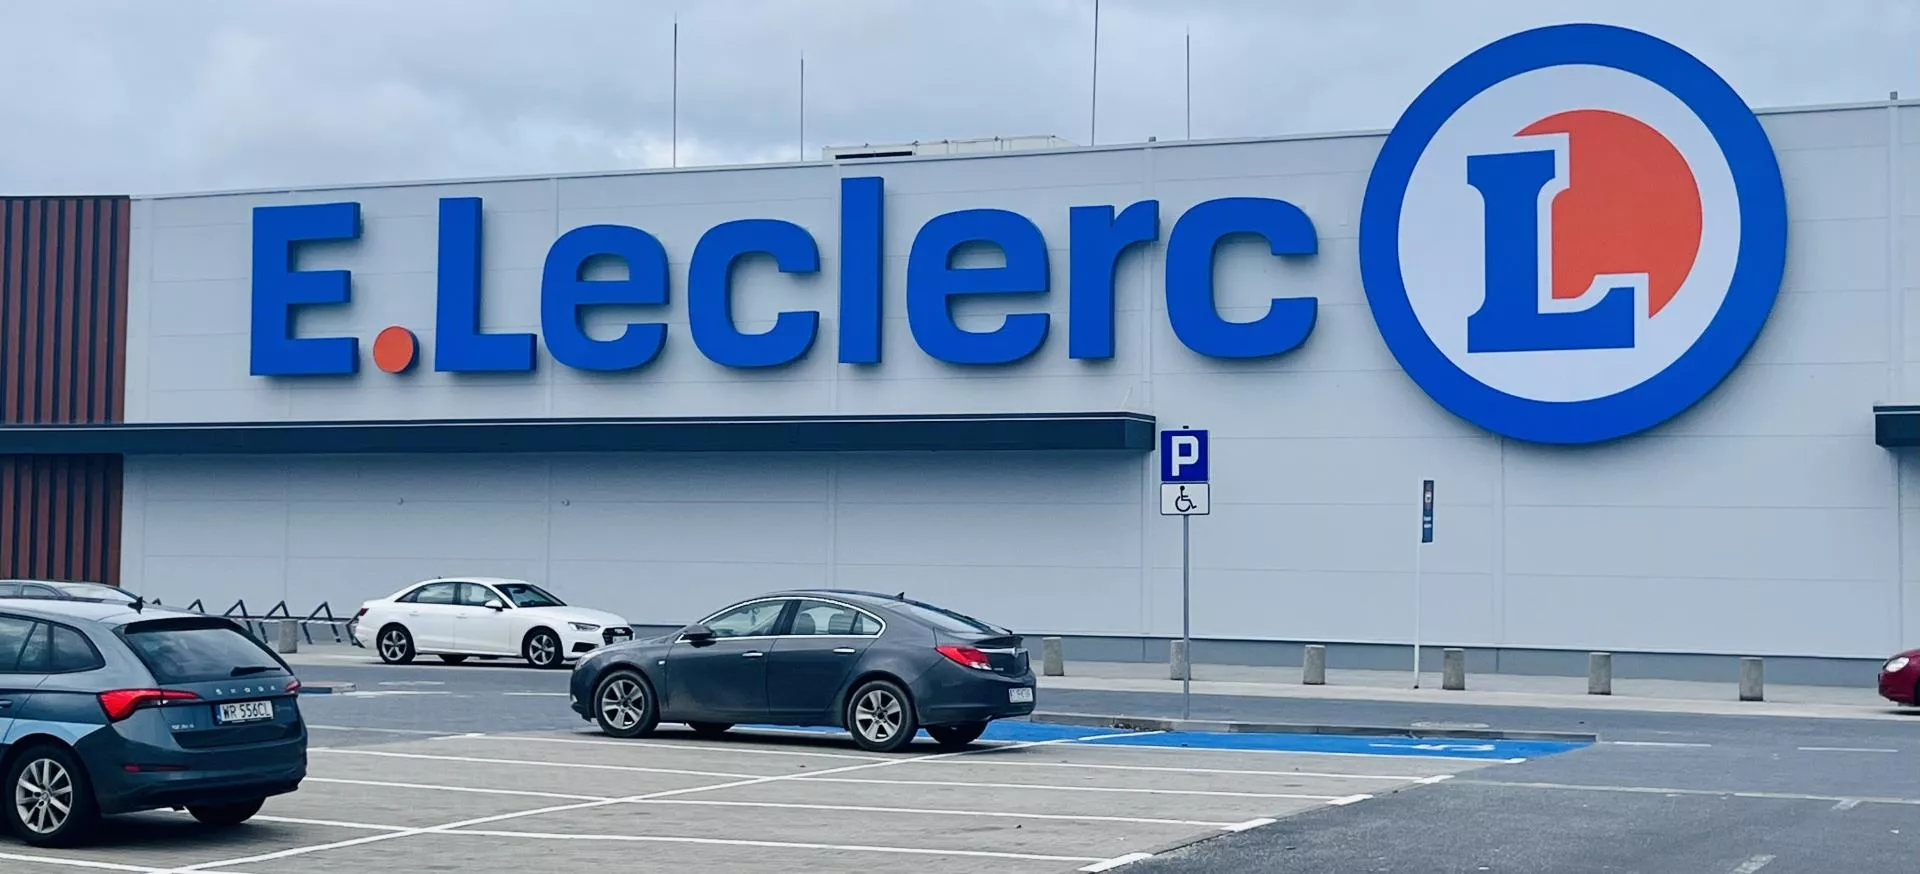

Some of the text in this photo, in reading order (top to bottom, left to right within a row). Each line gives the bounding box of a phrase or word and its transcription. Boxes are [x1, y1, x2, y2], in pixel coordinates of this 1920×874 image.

[250, 176, 1319, 376] E.Leclerc
[1467, 149, 1636, 354] L
[1171, 435, 1199, 477] P
[222, 702, 271, 719] WR 556CL
